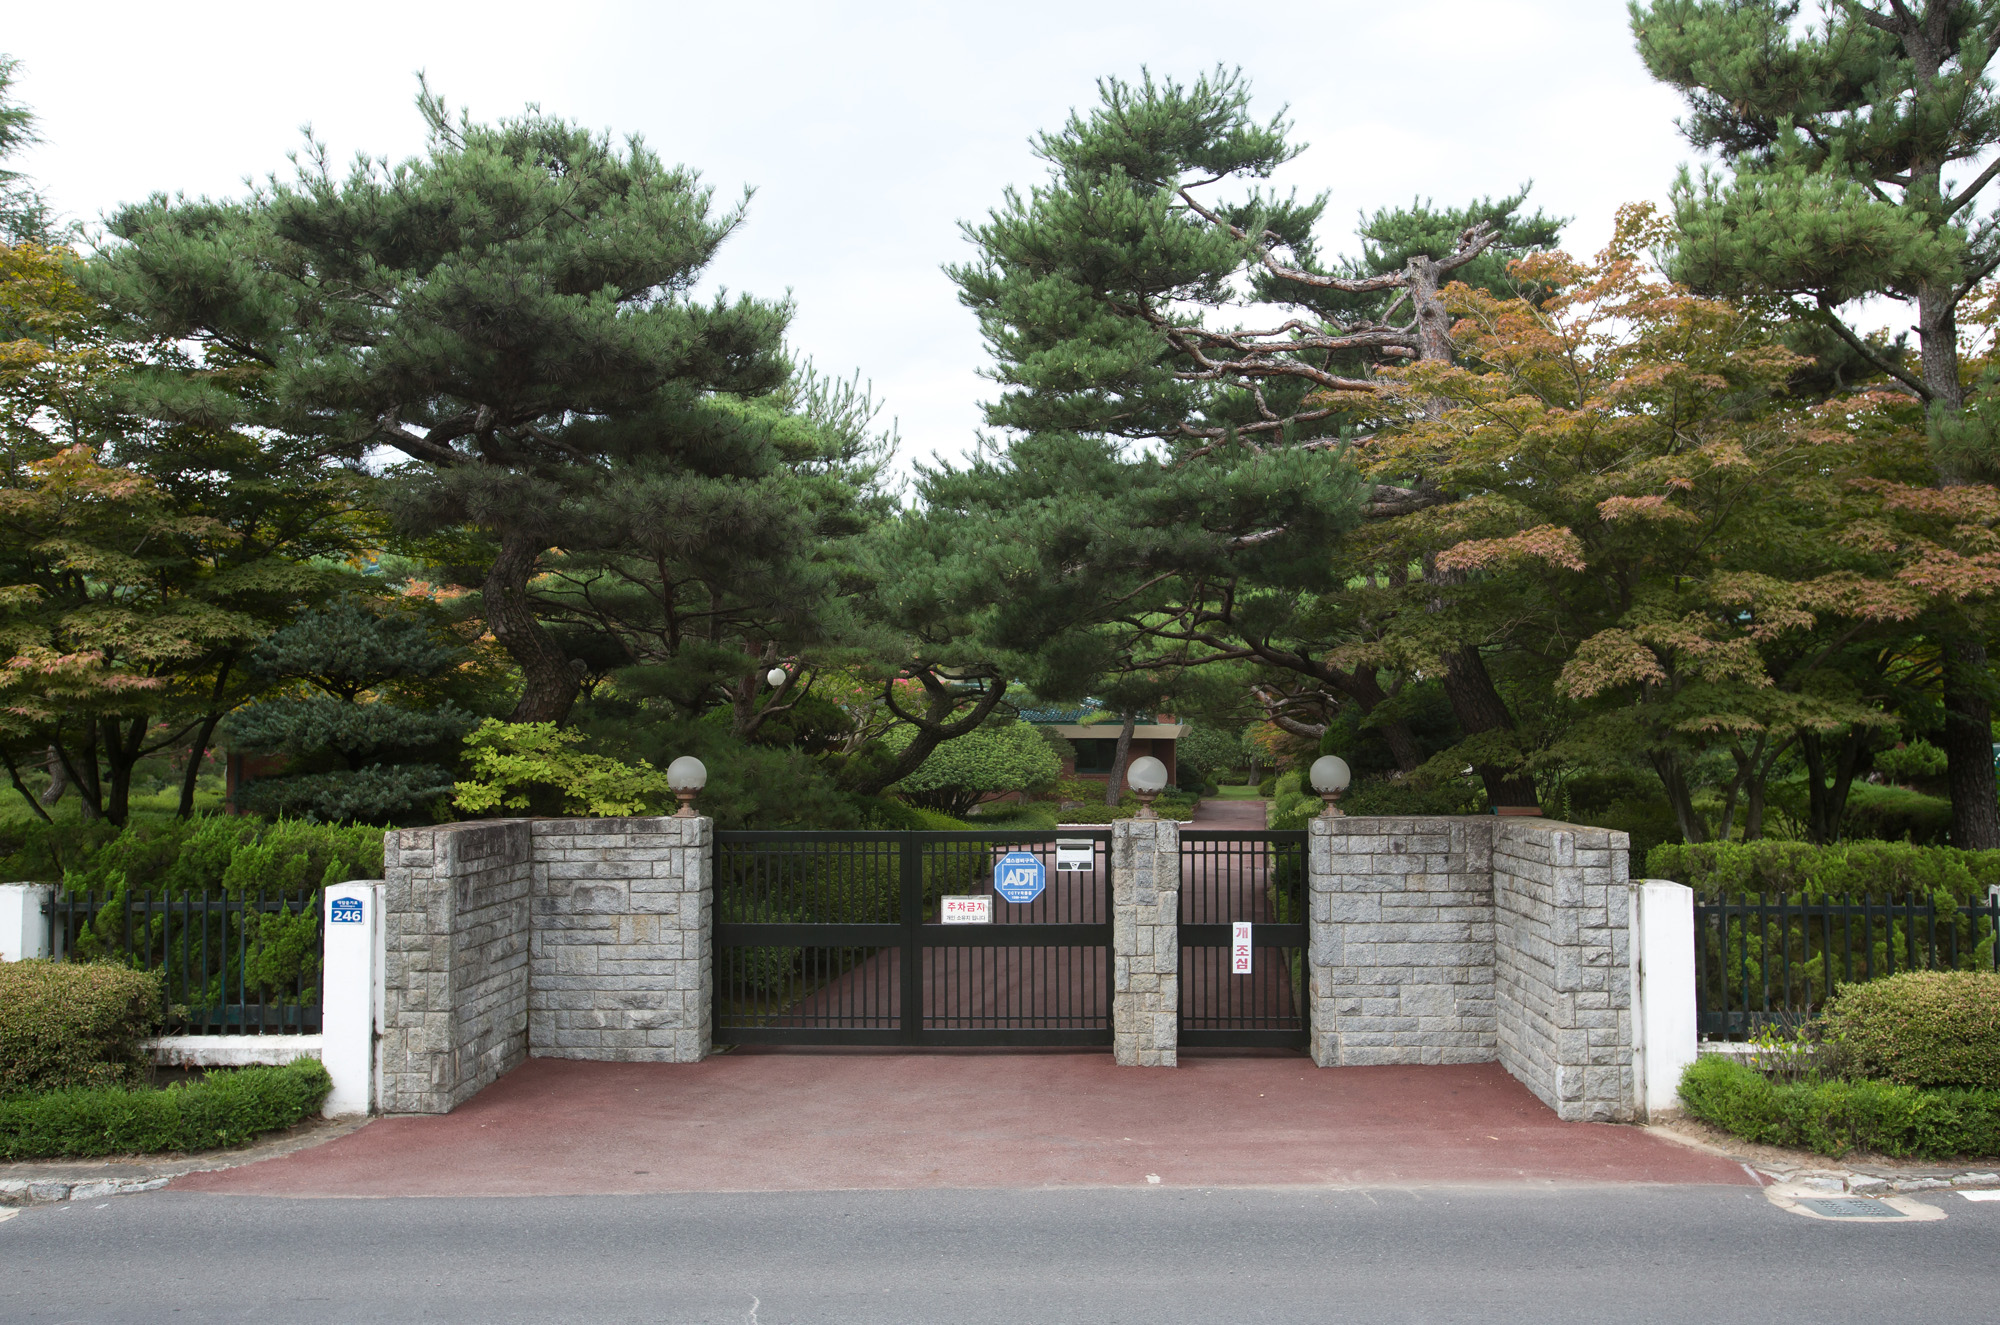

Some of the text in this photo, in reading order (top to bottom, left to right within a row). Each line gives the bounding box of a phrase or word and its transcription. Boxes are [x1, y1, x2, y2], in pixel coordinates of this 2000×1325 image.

[1003, 869, 1037, 886] ADT
[947, 902, 985, 912] 주차금지
[333, 910, 361, 921] 246
[1235, 927, 1249, 969] 개 조심
